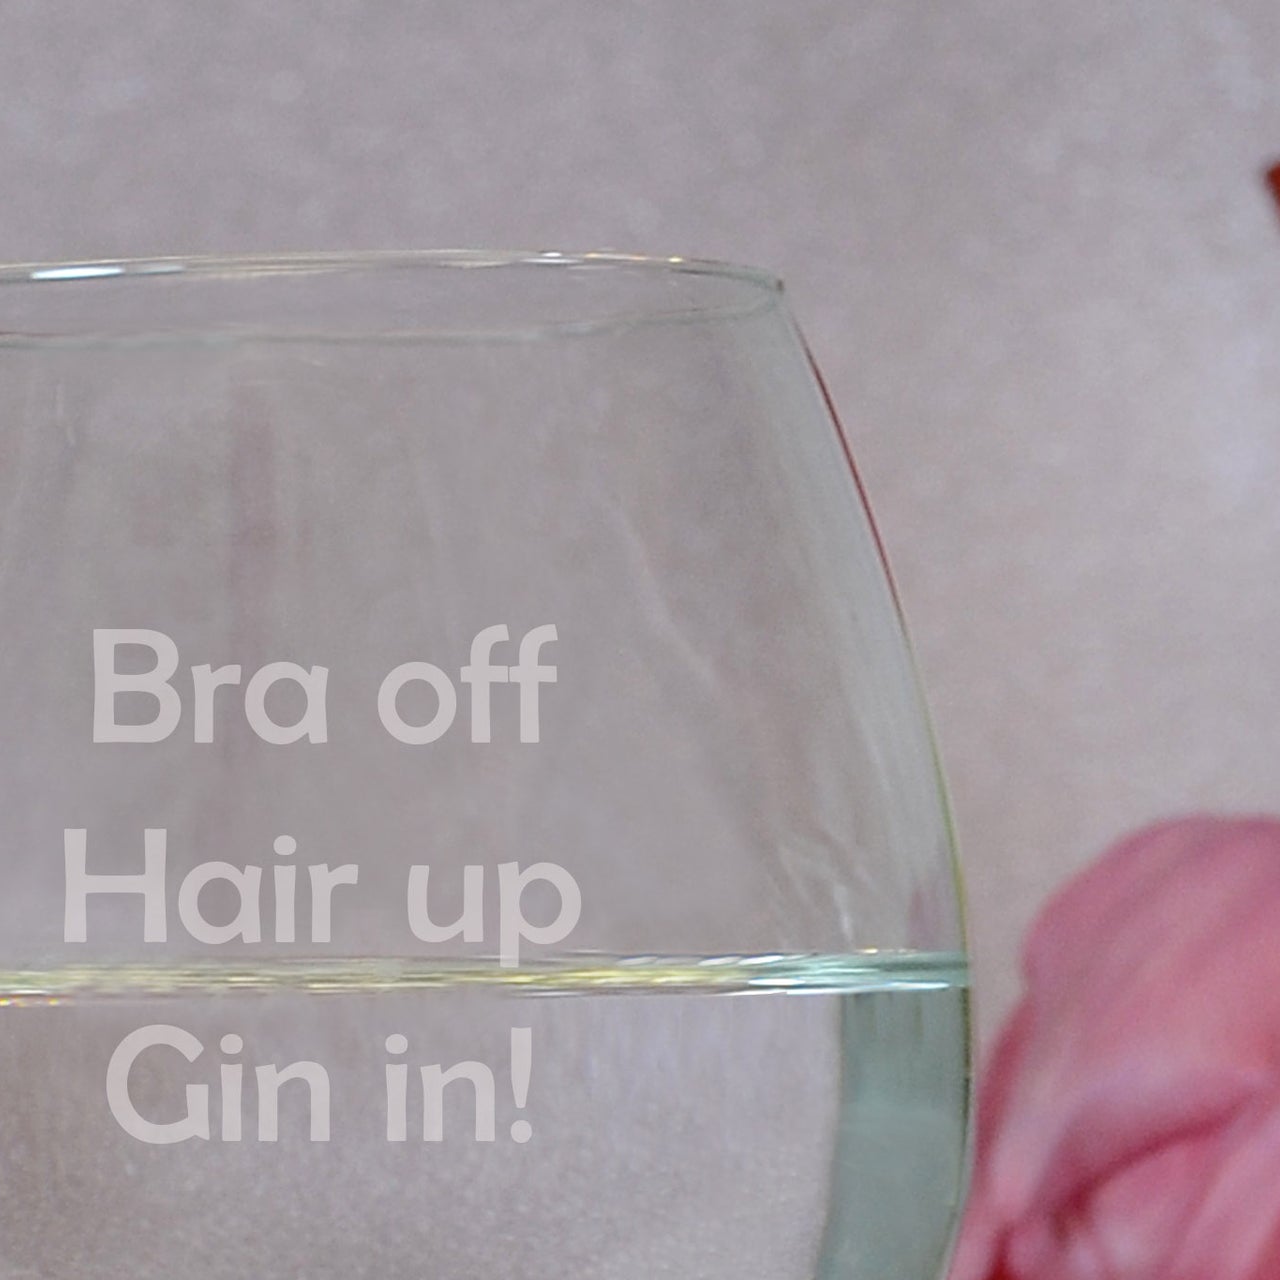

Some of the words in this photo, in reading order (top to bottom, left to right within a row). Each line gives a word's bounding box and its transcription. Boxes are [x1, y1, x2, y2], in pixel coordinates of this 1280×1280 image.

[93, 628, 329, 745] Bra
[377, 624, 558, 745] off
[63, 828, 358, 945] Hair
[407, 860, 582, 968] up
[106, 1024, 331, 1145] Gin
[385, 1027, 533, 1144] in!
